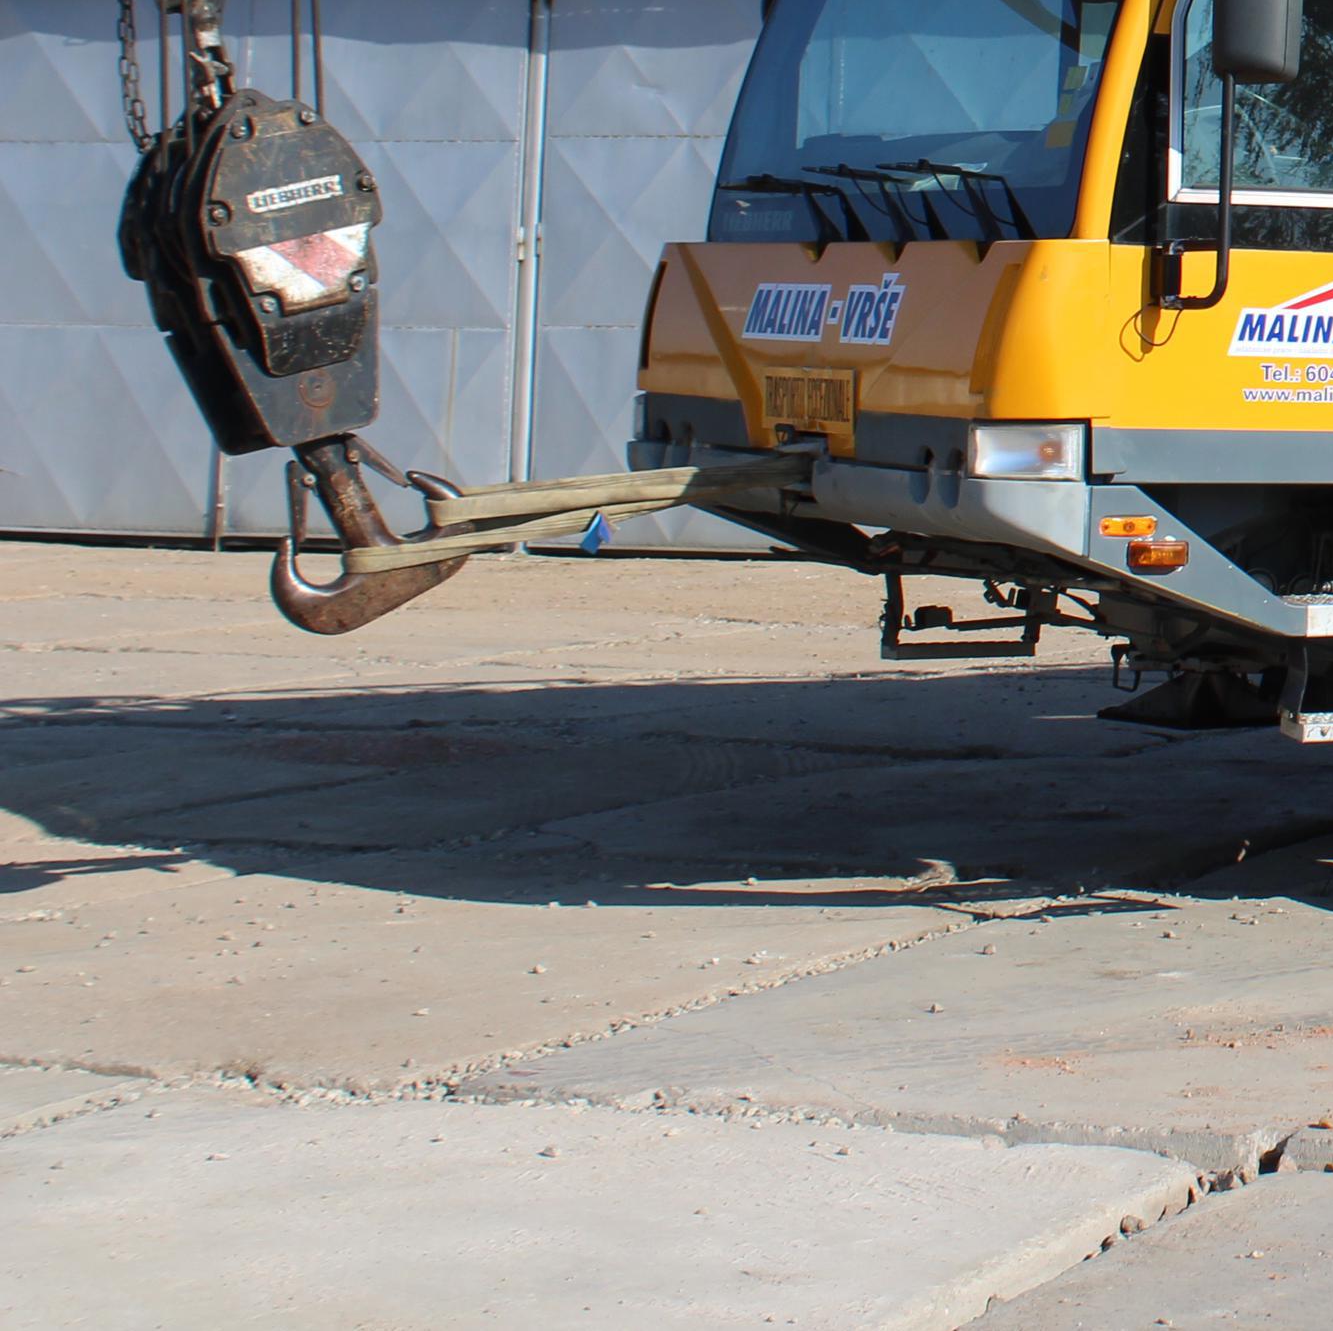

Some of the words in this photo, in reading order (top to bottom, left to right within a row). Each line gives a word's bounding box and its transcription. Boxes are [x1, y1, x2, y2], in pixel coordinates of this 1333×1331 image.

[252, 180, 339, 208] LIEBHERR
[744, 288, 829, 337] MALINA
[841, 278, 901, 340] VRŠE
[1261, 365, 1299, 382] Tel.:
